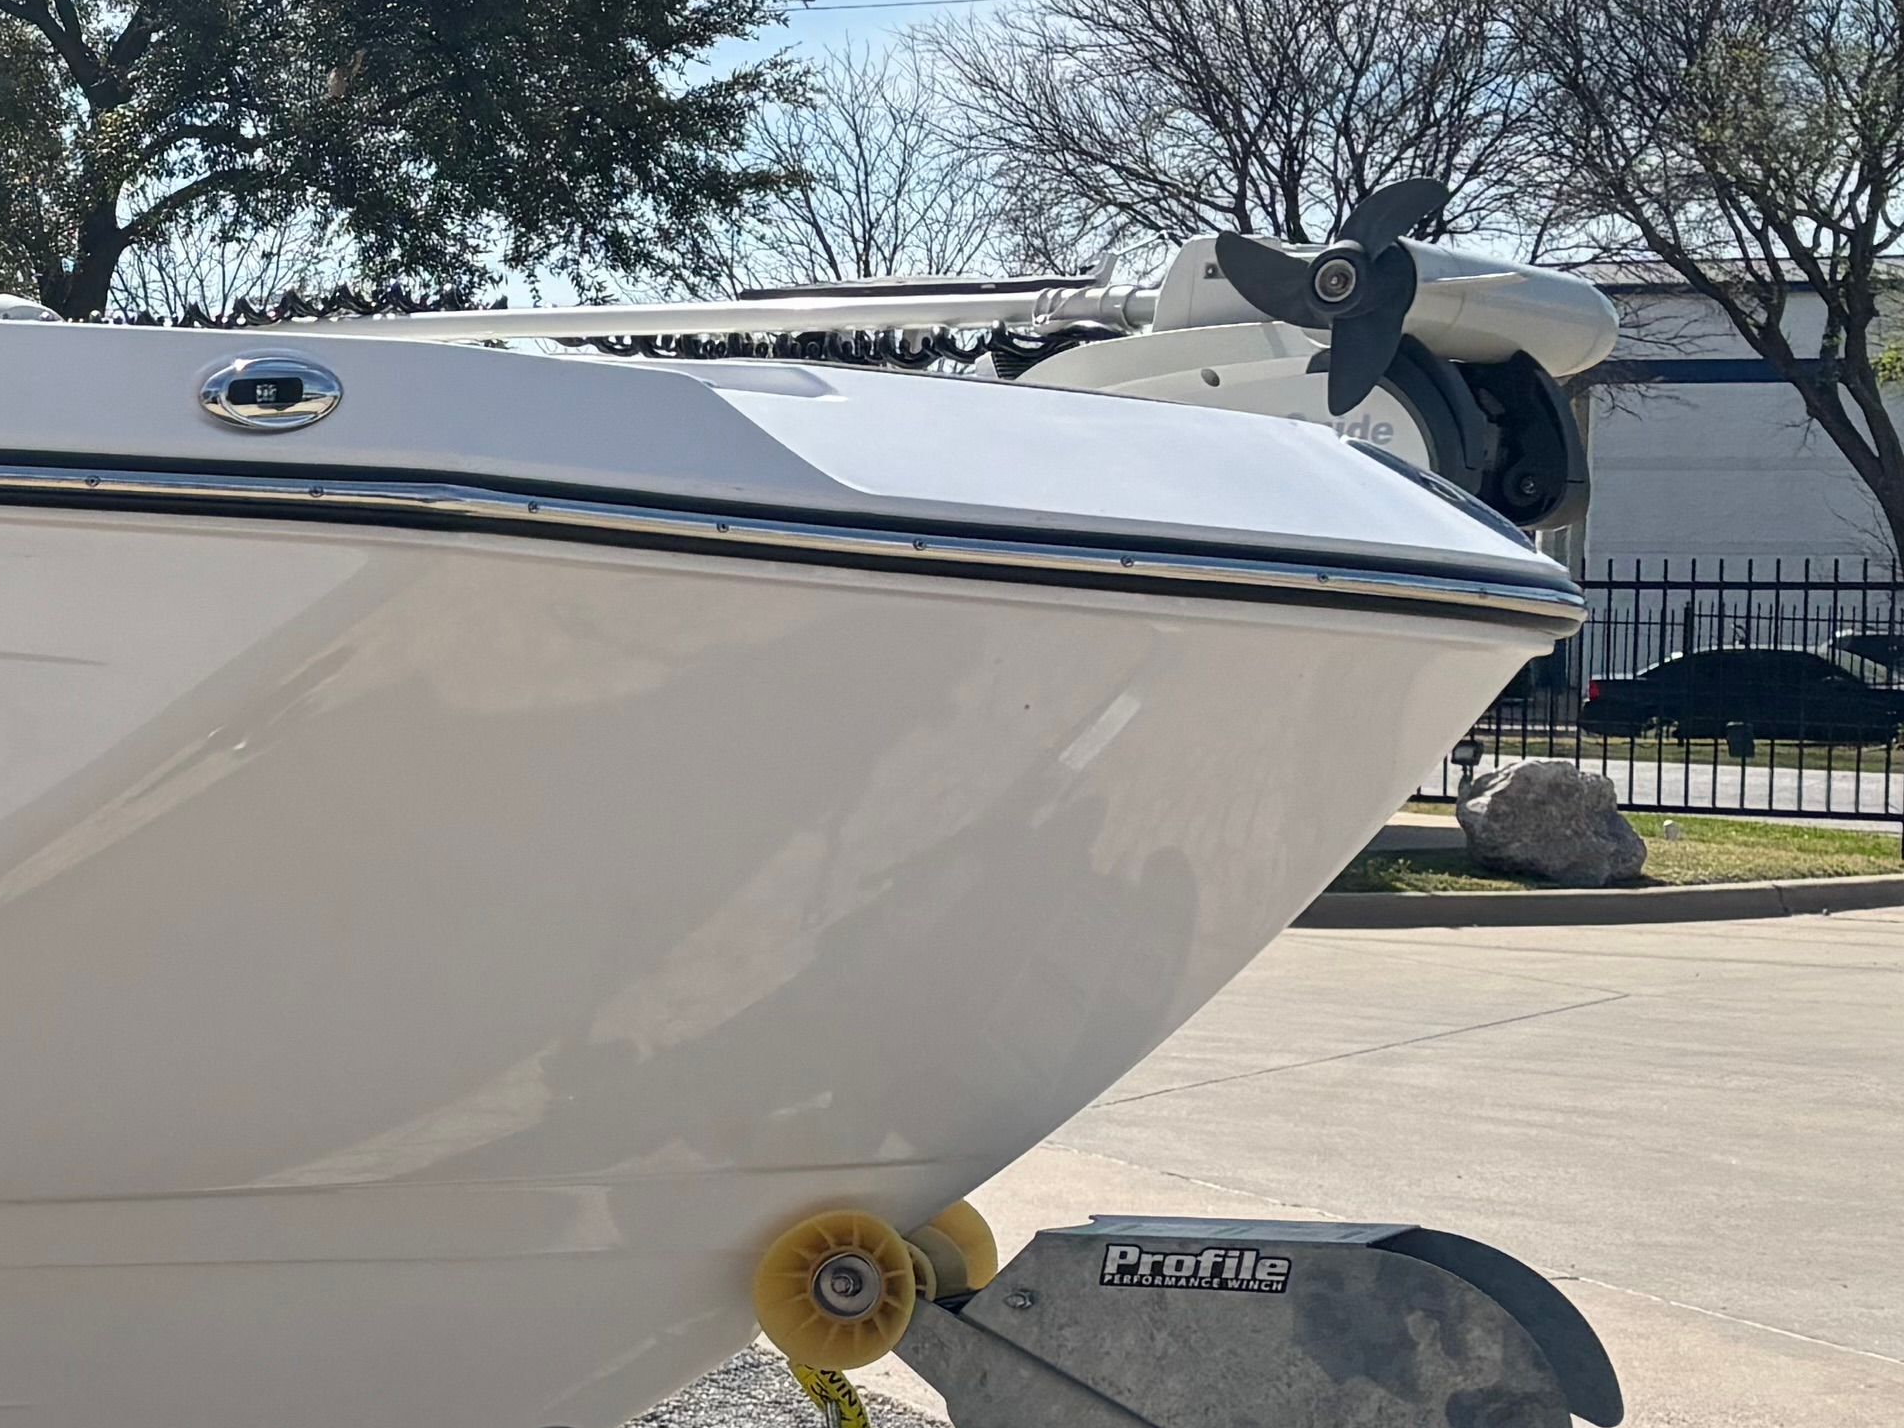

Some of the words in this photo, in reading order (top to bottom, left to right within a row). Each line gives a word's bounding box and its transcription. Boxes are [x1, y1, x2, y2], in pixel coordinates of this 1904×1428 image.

[1104, 1245, 1290, 1281] Profile
[1103, 1274, 1221, 1288] PERFORMANCE
[1227, 1279, 1283, 1291] WINCH
